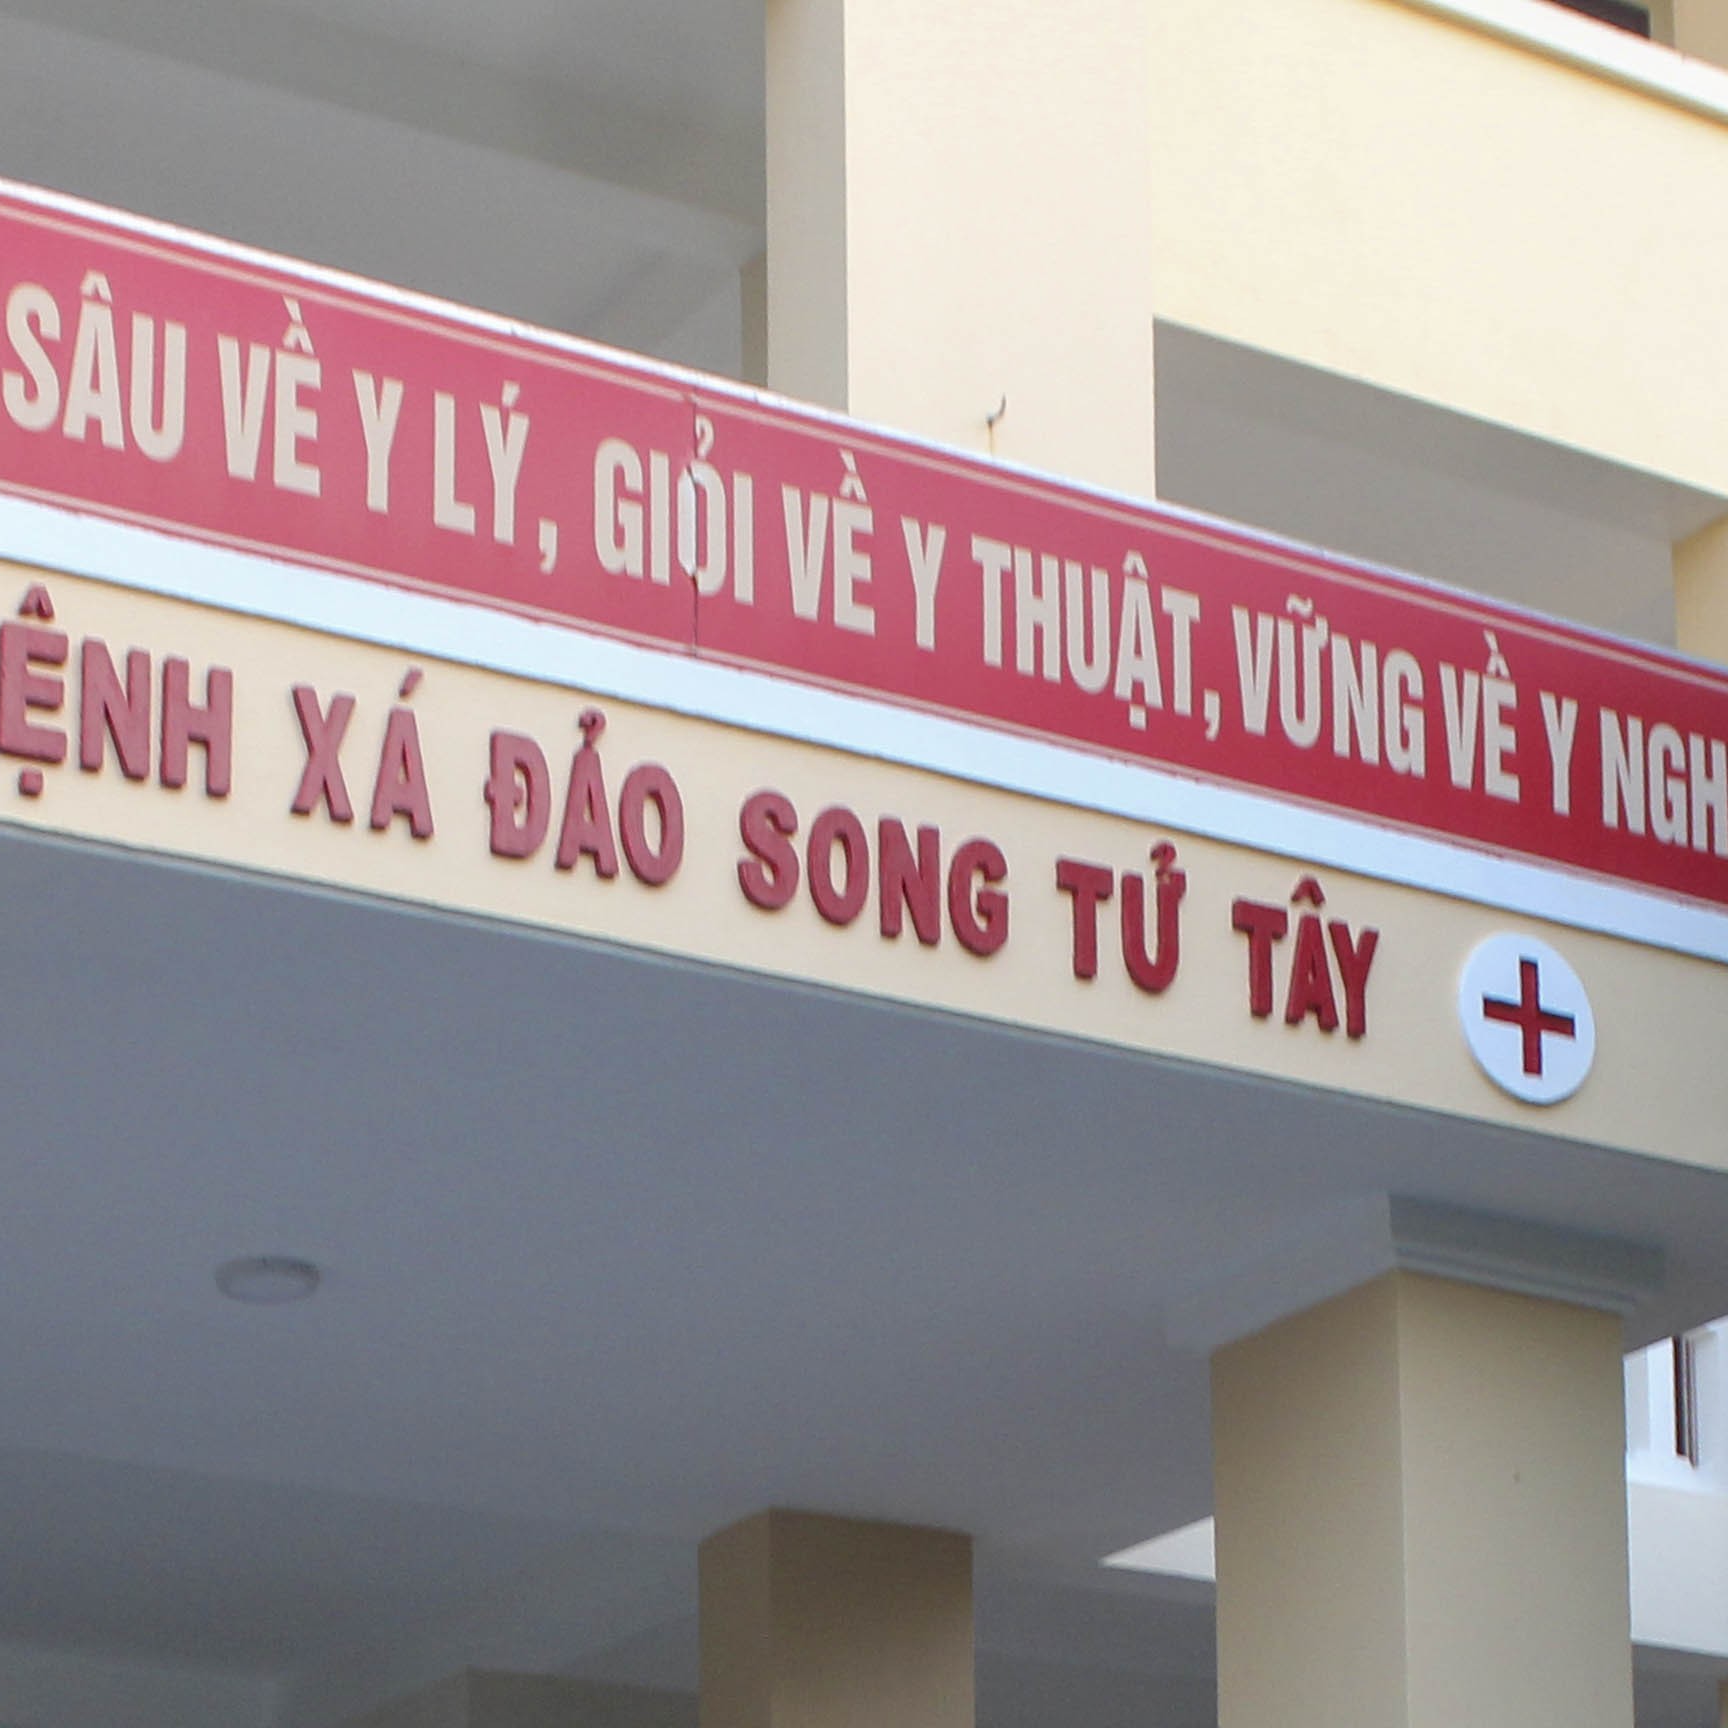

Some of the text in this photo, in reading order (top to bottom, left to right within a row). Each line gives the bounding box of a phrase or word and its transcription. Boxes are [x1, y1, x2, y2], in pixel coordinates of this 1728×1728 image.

[2, 270, 187, 462] SÂU
[217, 296, 322, 498] VỀ
[352, 369, 404, 514] Y
[593, 415, 754, 605] GIỎI
[781, 450, 876, 635] VỀ
[900, 516, 947, 650] Y
[971, 534, 1220, 742] THUẬT,
[1232, 595, 1425, 777] VỮNG
[1440, 629, 1519, 801] VỀ
[1540, 692, 1577, 815] Y
[294, 671, 434, 841] XÁ
[484, 711, 684, 888] ĐẢO
[738, 791, 1009, 957] SONG
[1056, 841, 1186, 994] TỬ
[1232, 876, 1379, 1039] TÂY
